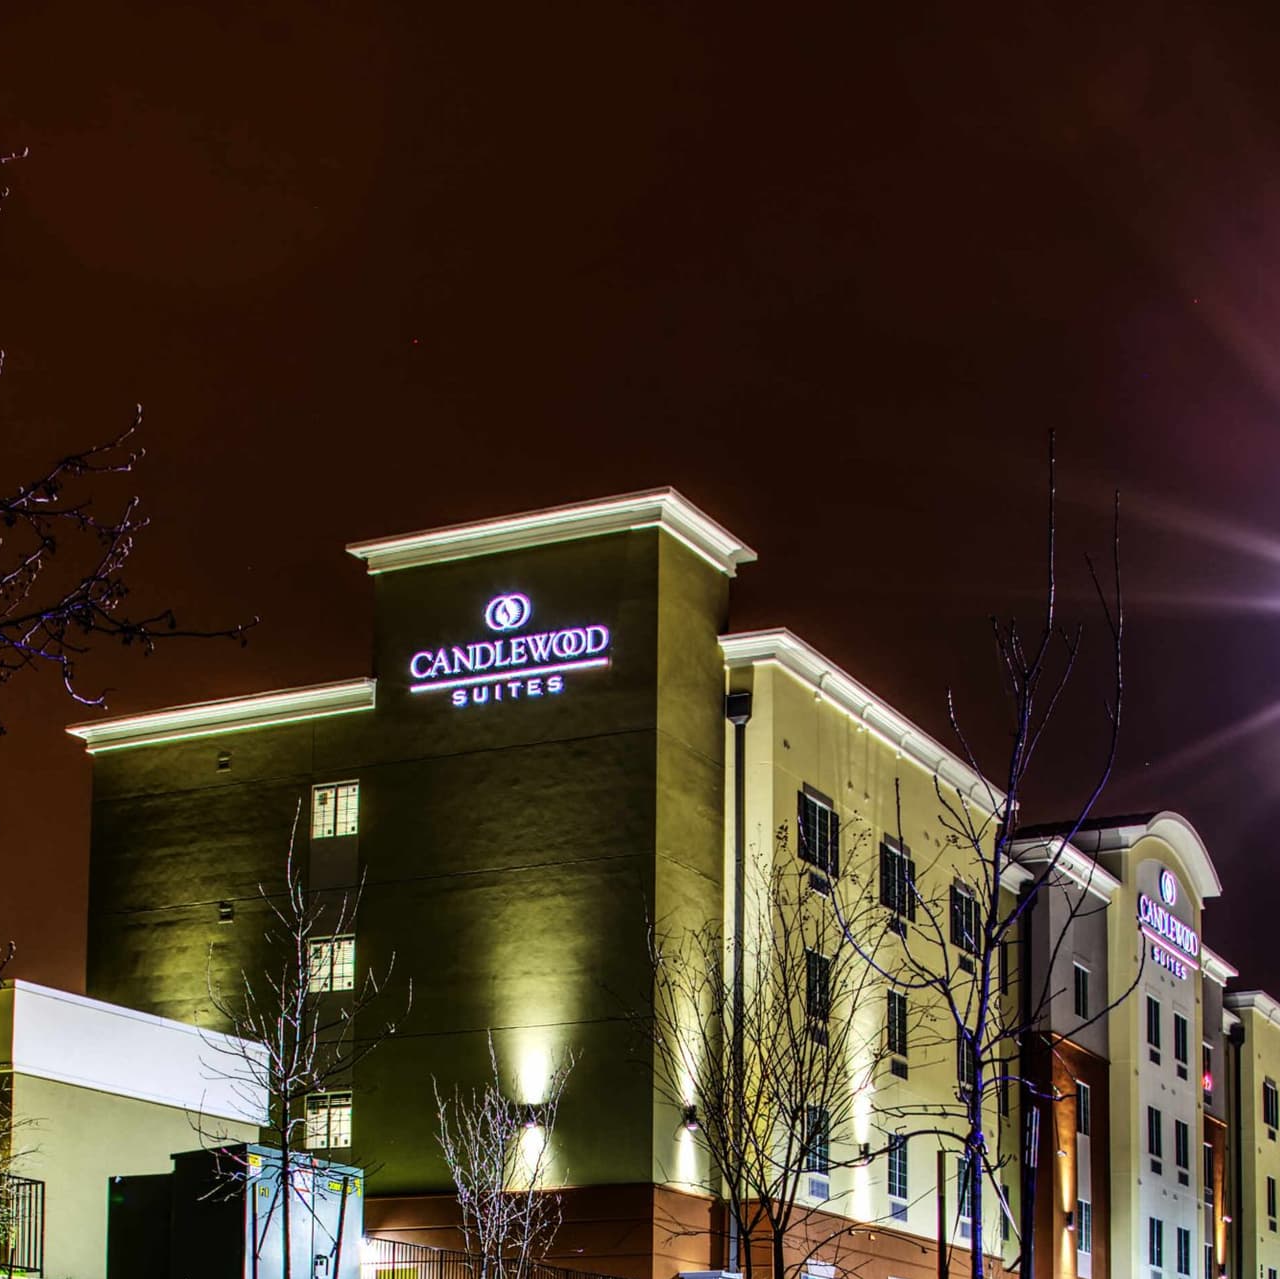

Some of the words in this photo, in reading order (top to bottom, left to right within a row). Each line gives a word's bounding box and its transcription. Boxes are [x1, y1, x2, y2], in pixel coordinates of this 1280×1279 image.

[411, 625, 609, 678] CANDLEWOOD
[452, 676, 563, 705] SUITES
[1153, 947, 1187, 980] SUITES
